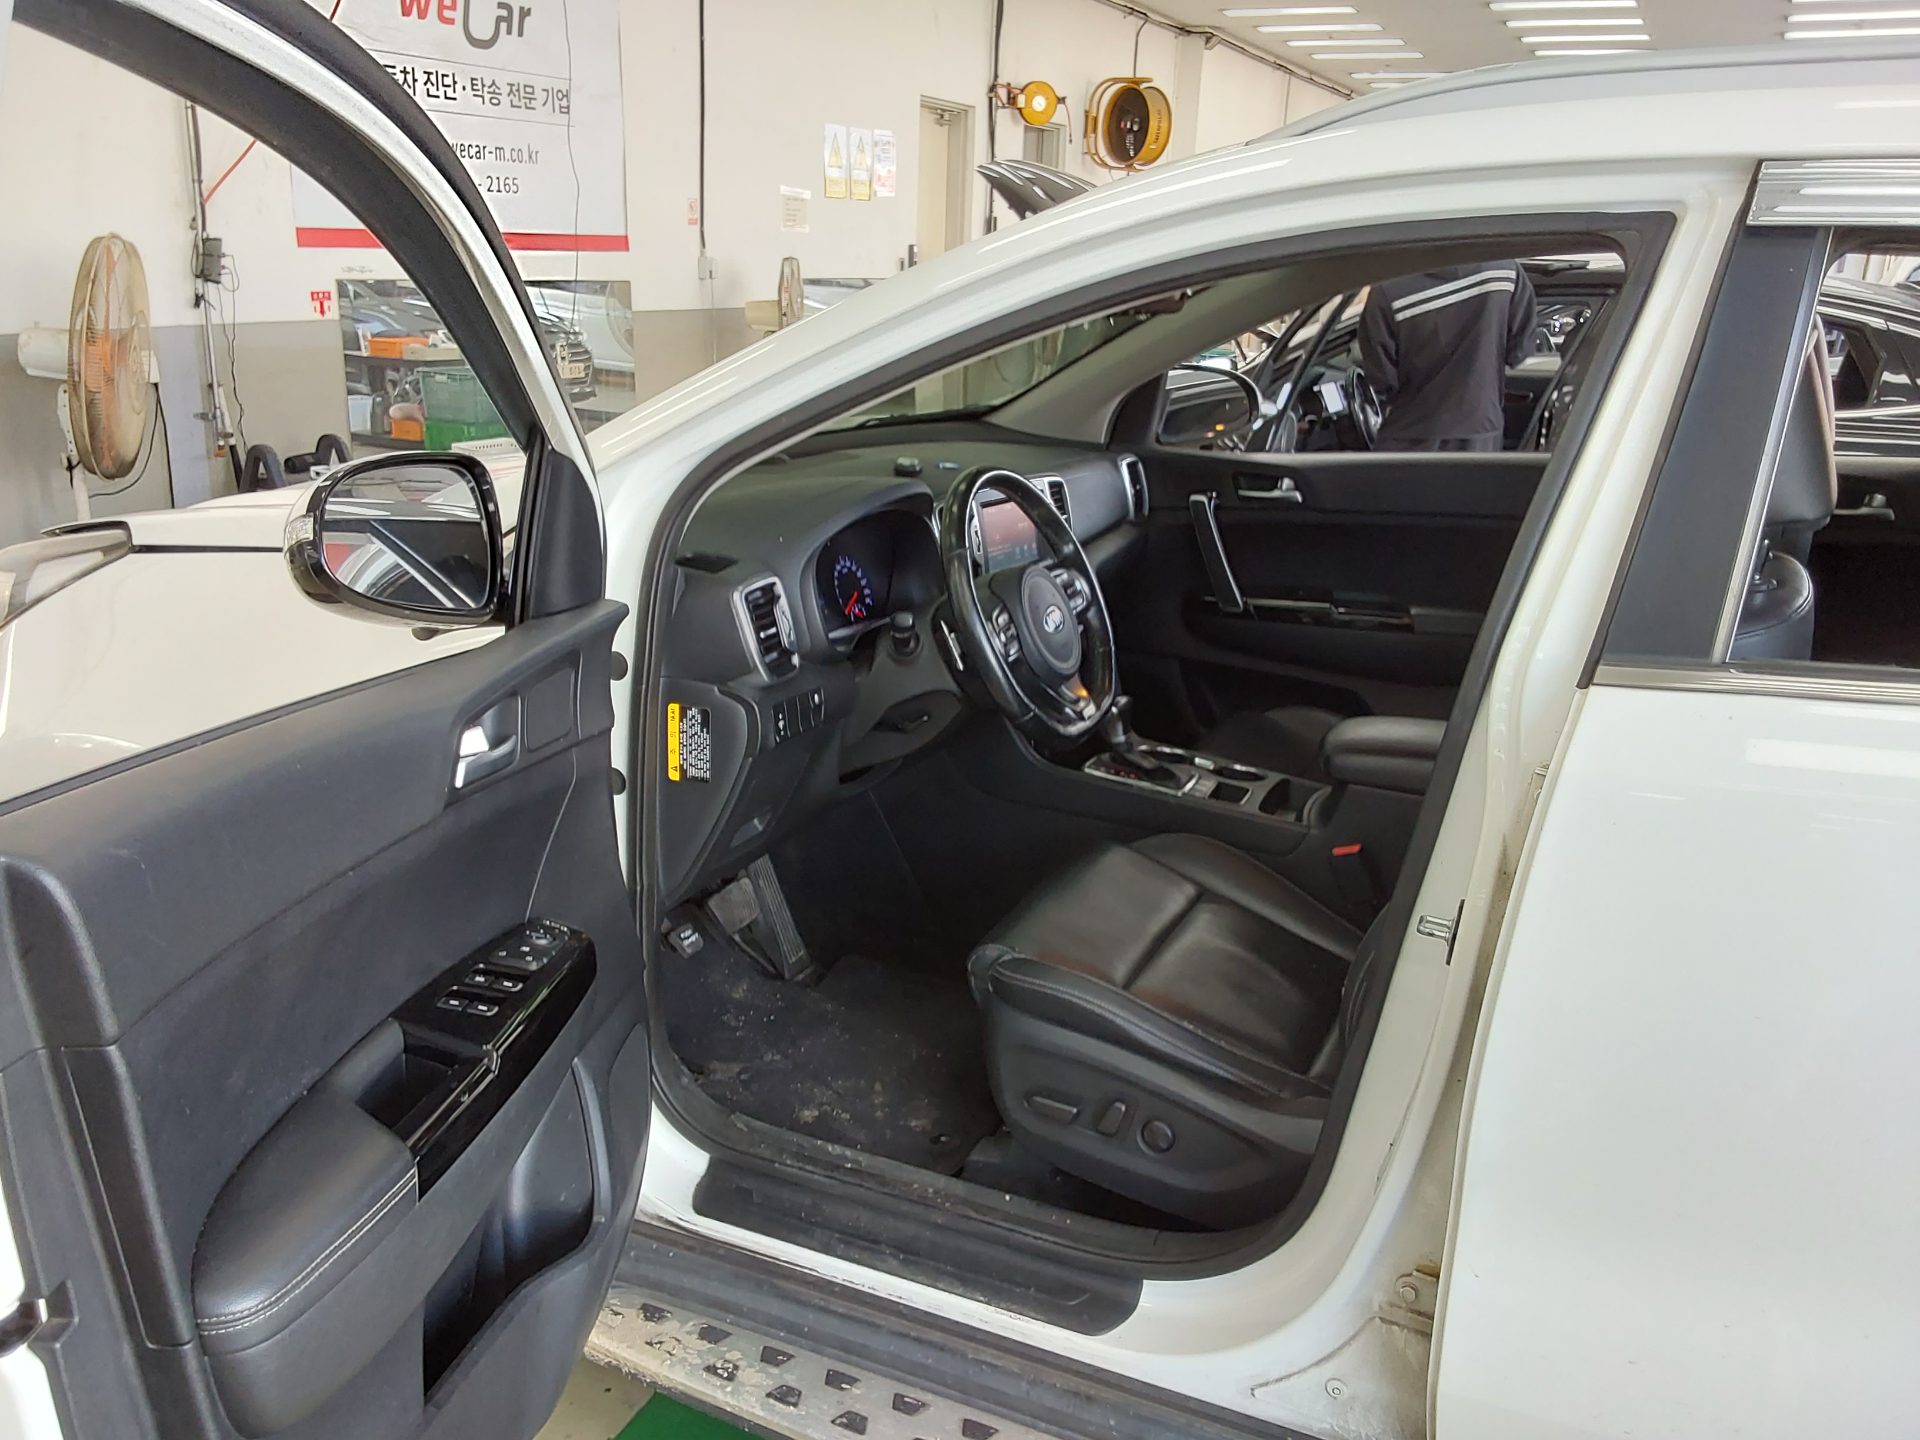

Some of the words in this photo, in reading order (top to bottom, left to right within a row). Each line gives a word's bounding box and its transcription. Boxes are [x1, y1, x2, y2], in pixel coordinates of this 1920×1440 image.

[506, 82, 537, 110] 전문
[541, 86, 570, 115] 기업
[486, 175, 519, 194] 2165
